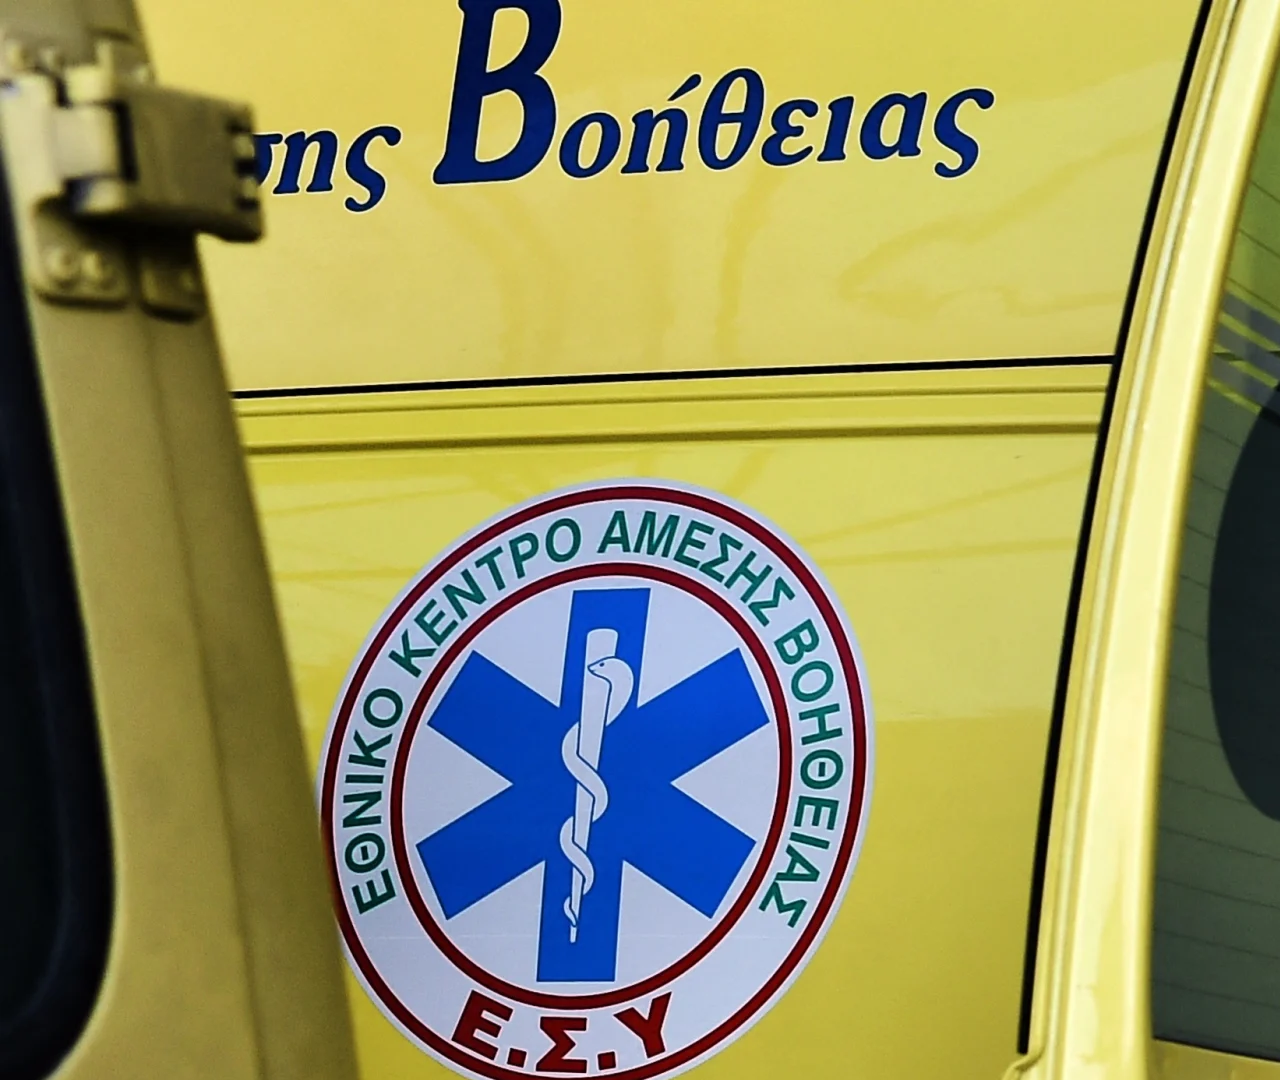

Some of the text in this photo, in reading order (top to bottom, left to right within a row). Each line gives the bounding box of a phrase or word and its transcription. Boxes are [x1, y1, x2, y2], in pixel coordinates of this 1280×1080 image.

[432, 0, 996, 185] Βοήθειας
[344, 509, 845, 929] ΕΘΝΙΚΟ ΚΕΝΤΡΟ ΑΜΕΣΗΣ ΒΟΗΘΕΙΑΣ
[450, 989, 673, 1074] Ε.Σ.Υ
